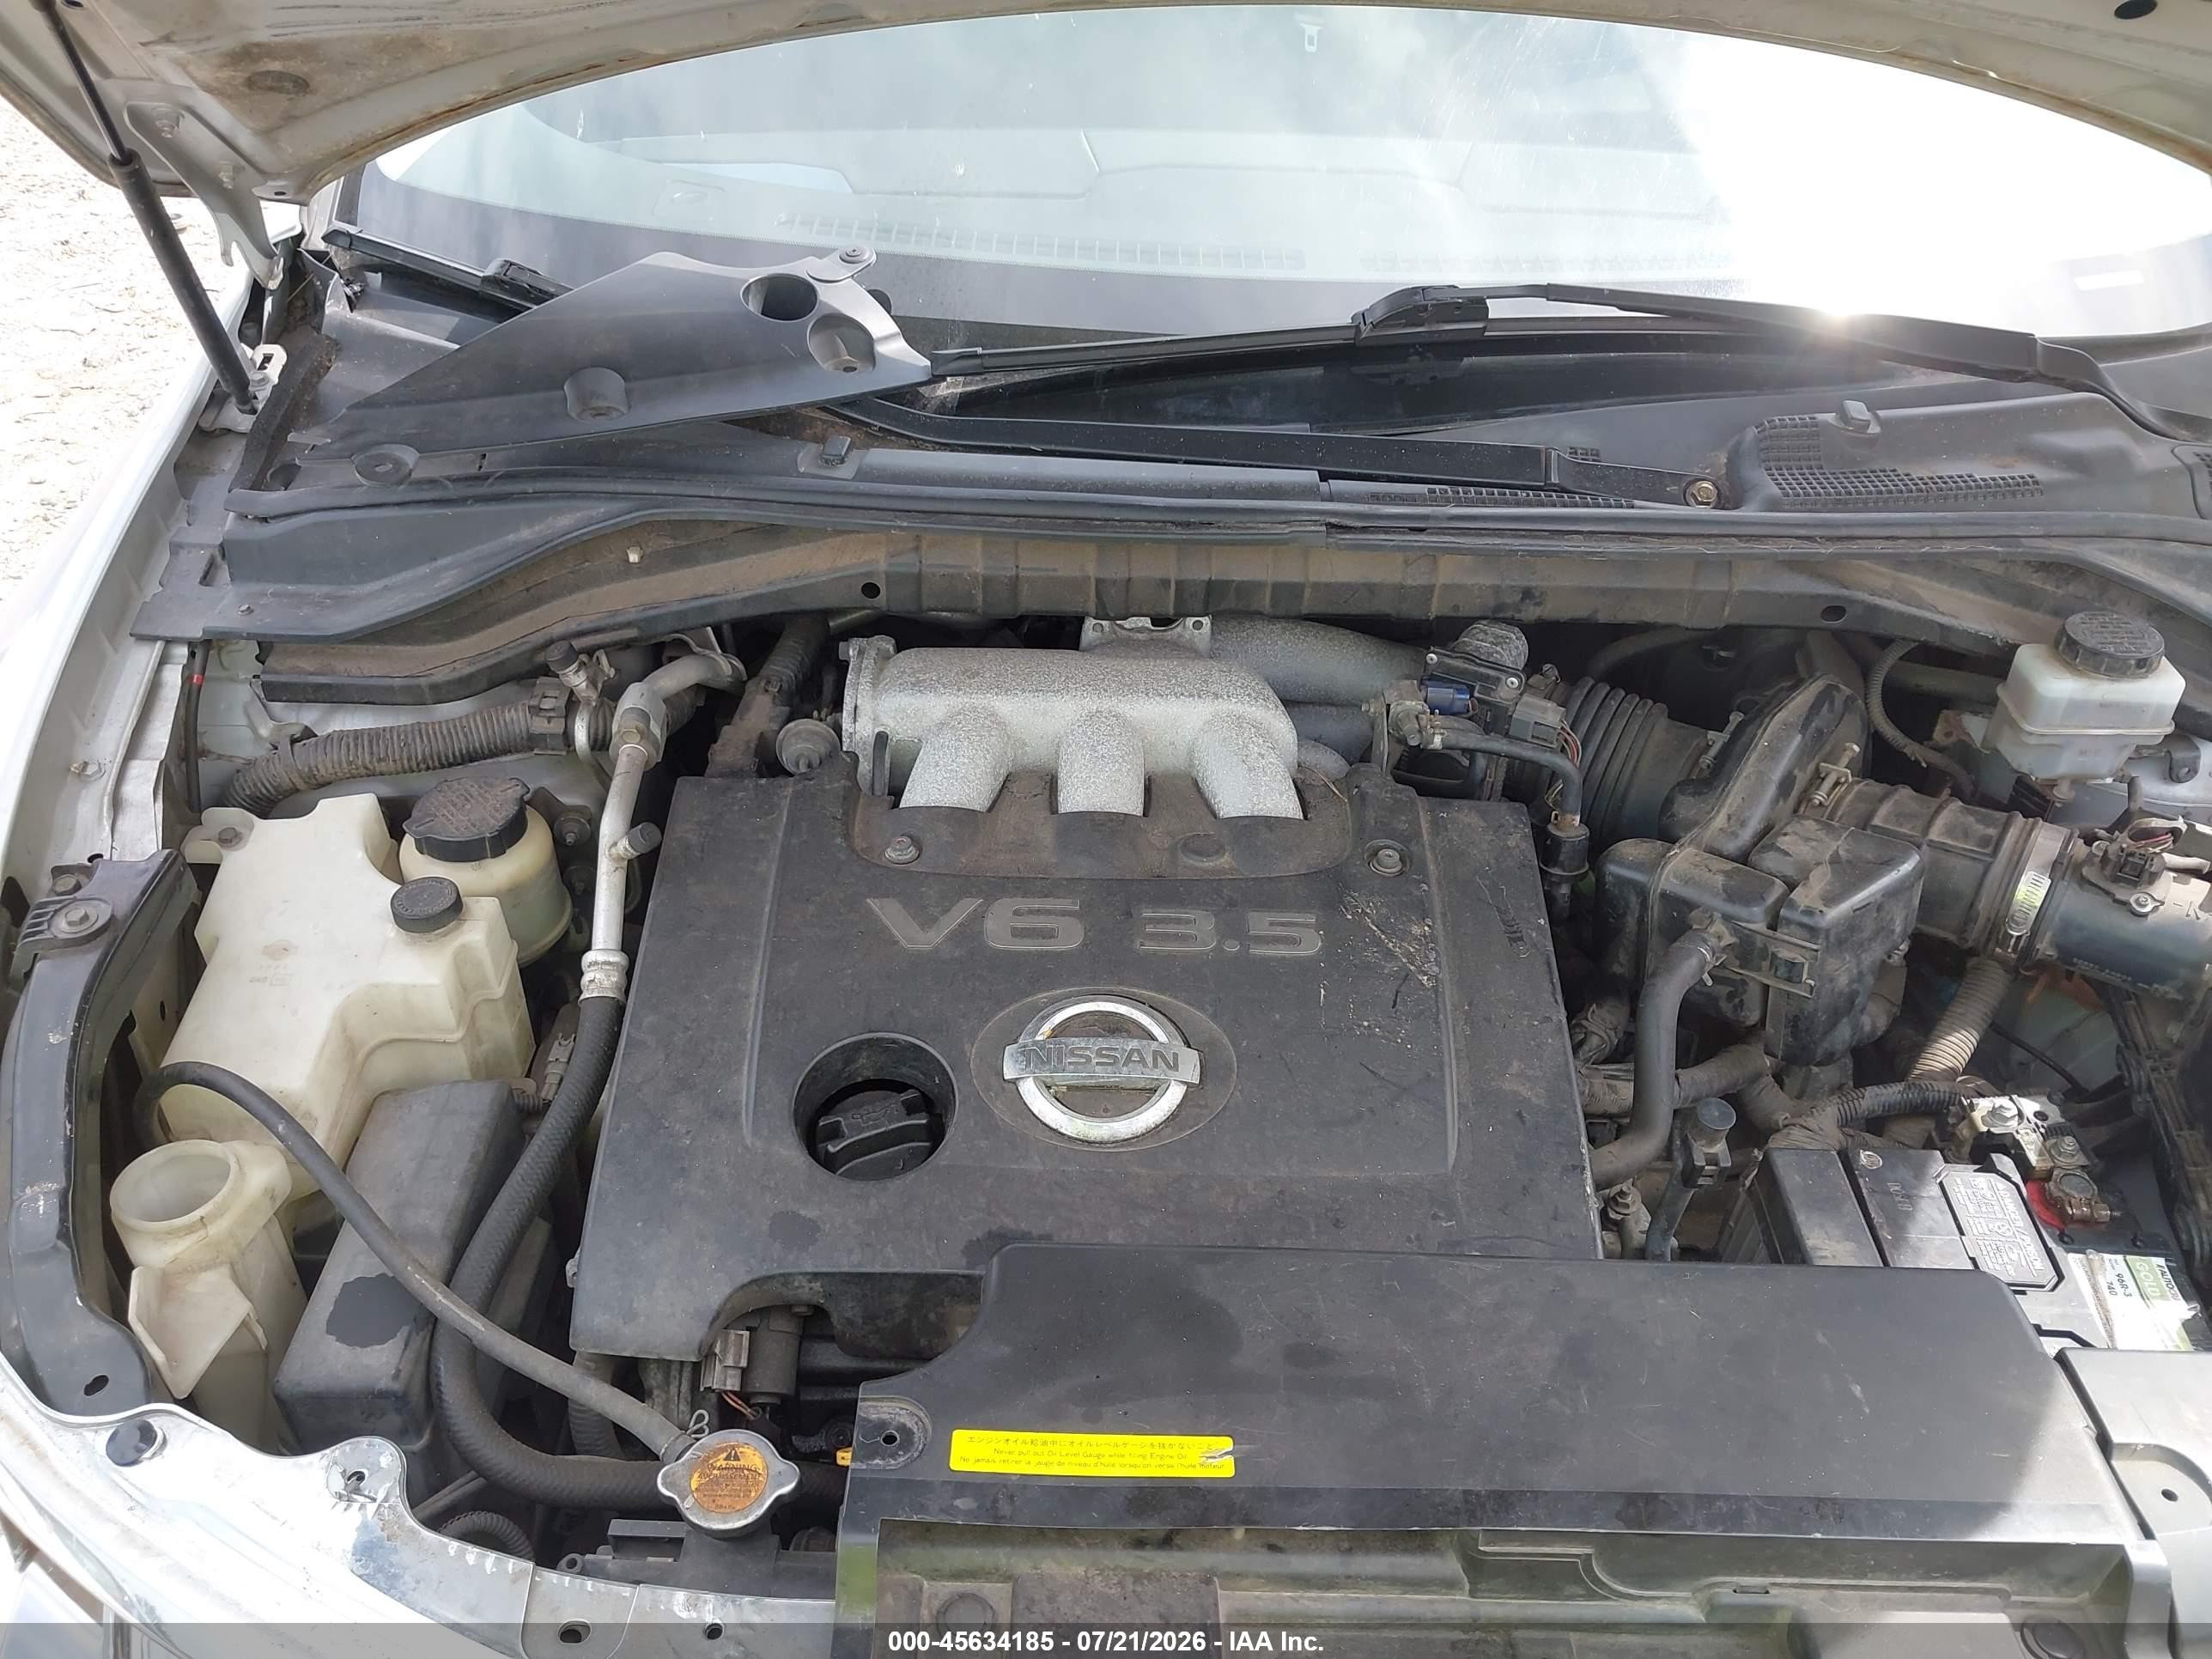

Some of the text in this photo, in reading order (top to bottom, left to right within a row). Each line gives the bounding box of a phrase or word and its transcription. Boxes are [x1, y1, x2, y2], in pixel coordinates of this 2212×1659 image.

[865, 896, 1323, 956] V6 3.5
[1024, 1044, 1181, 1073] NISSAN
[2116, 1273, 2132, 1297] 96R-3
[2136, 1261, 2160, 1297] GOLD
[1082, 1451, 1105, 1460] Gauge
[1150, 1452, 1175, 1462] Engine
